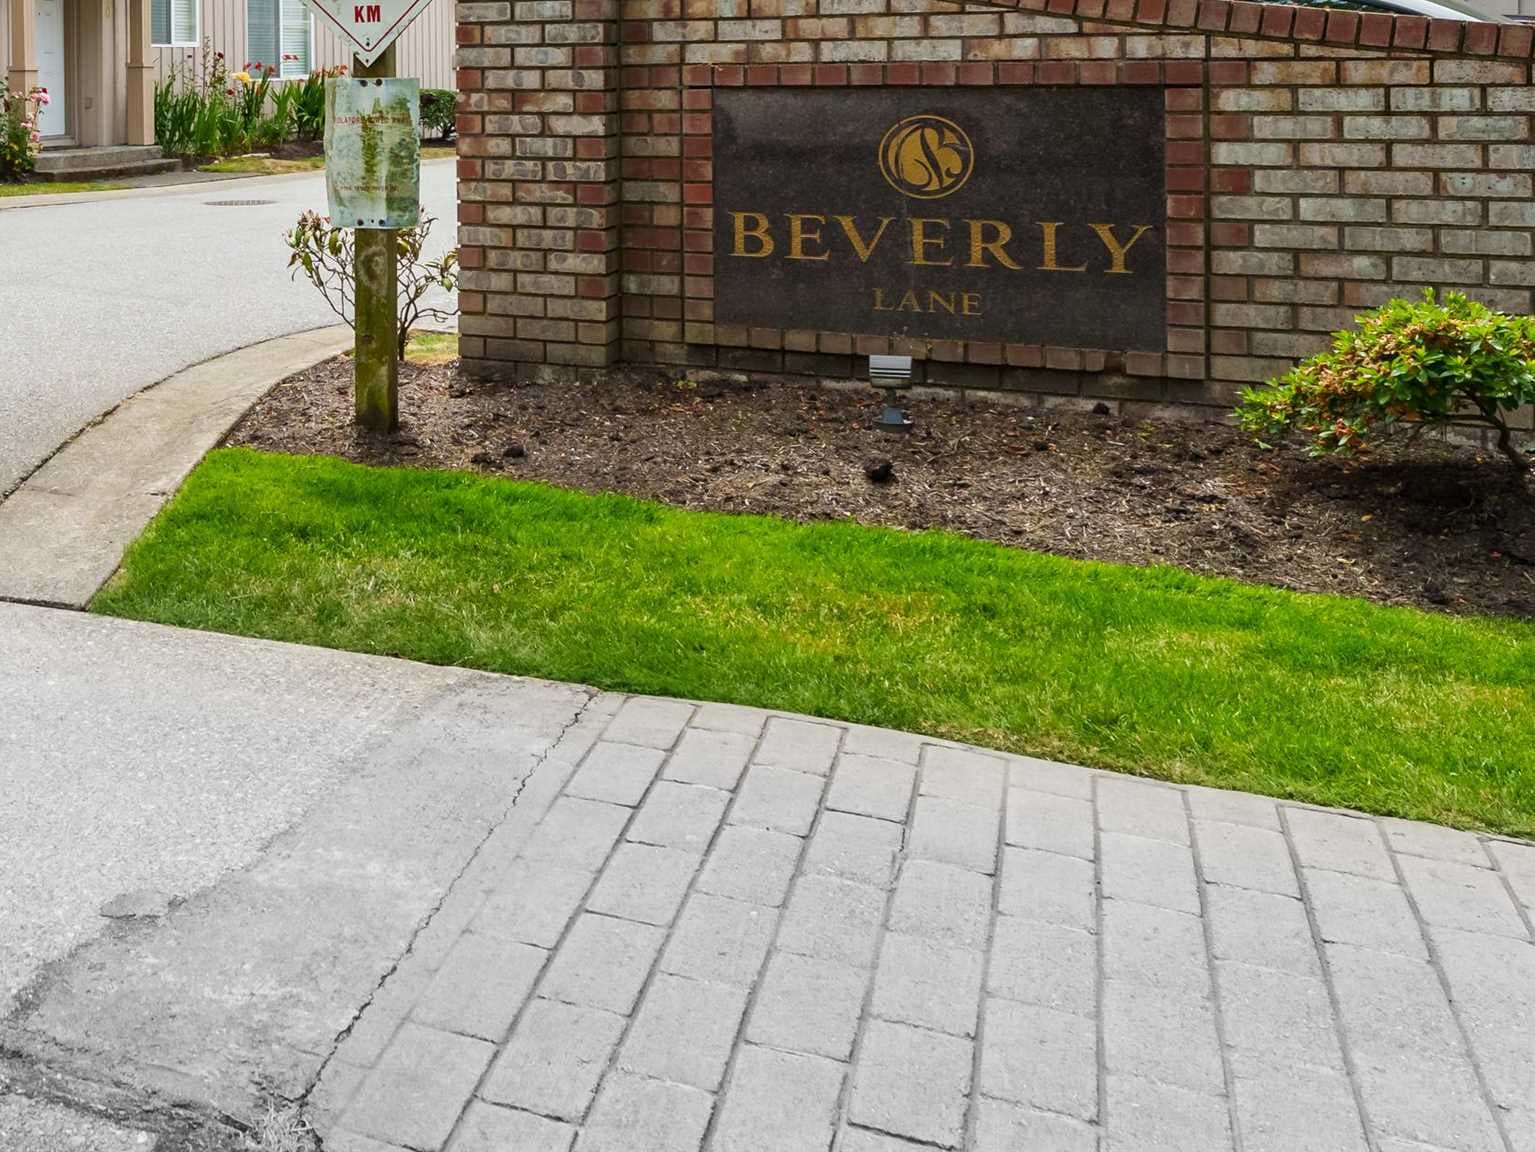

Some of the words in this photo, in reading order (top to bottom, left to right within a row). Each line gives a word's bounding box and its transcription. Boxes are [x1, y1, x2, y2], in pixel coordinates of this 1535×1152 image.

[354, 5, 381, 23] KM
[727, 210, 1154, 274] BEVERLY
[872, 288, 985, 315] LANE
